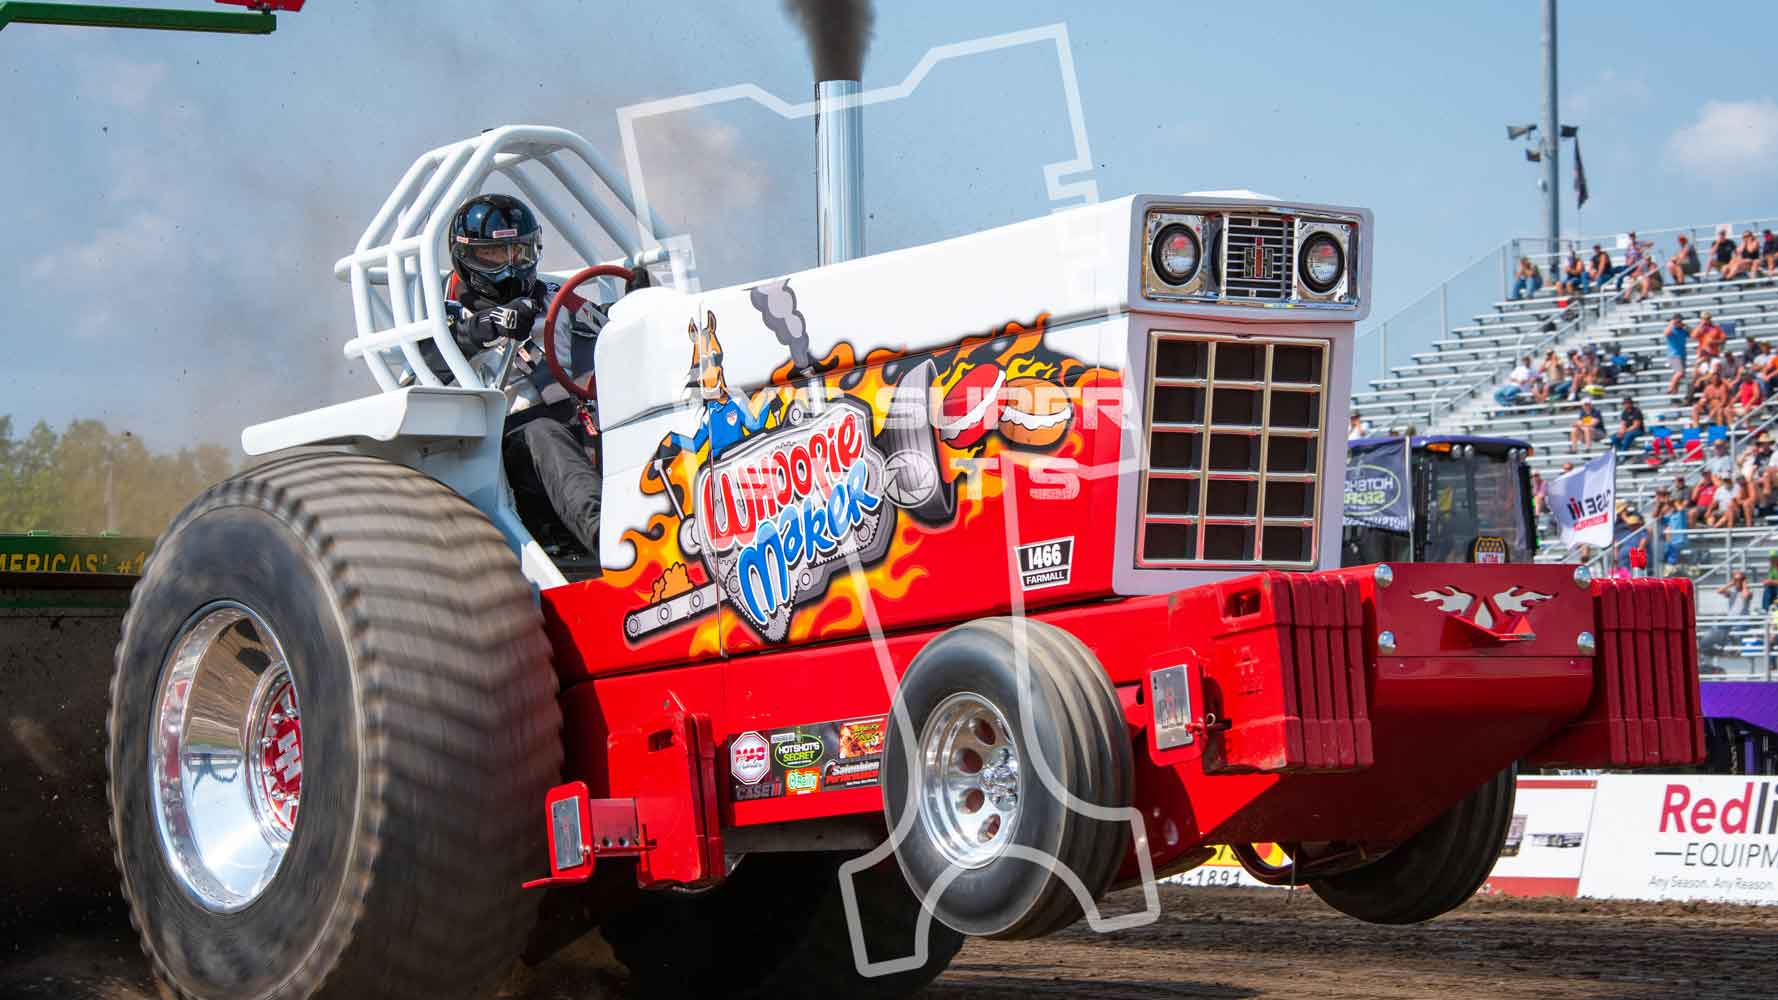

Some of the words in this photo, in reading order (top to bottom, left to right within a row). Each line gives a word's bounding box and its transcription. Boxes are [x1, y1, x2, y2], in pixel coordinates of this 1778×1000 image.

[1028, 543, 1061, 570] 1466
[1026, 571, 1065, 585] FARMALL
[783, 750, 815, 762] SECRET
